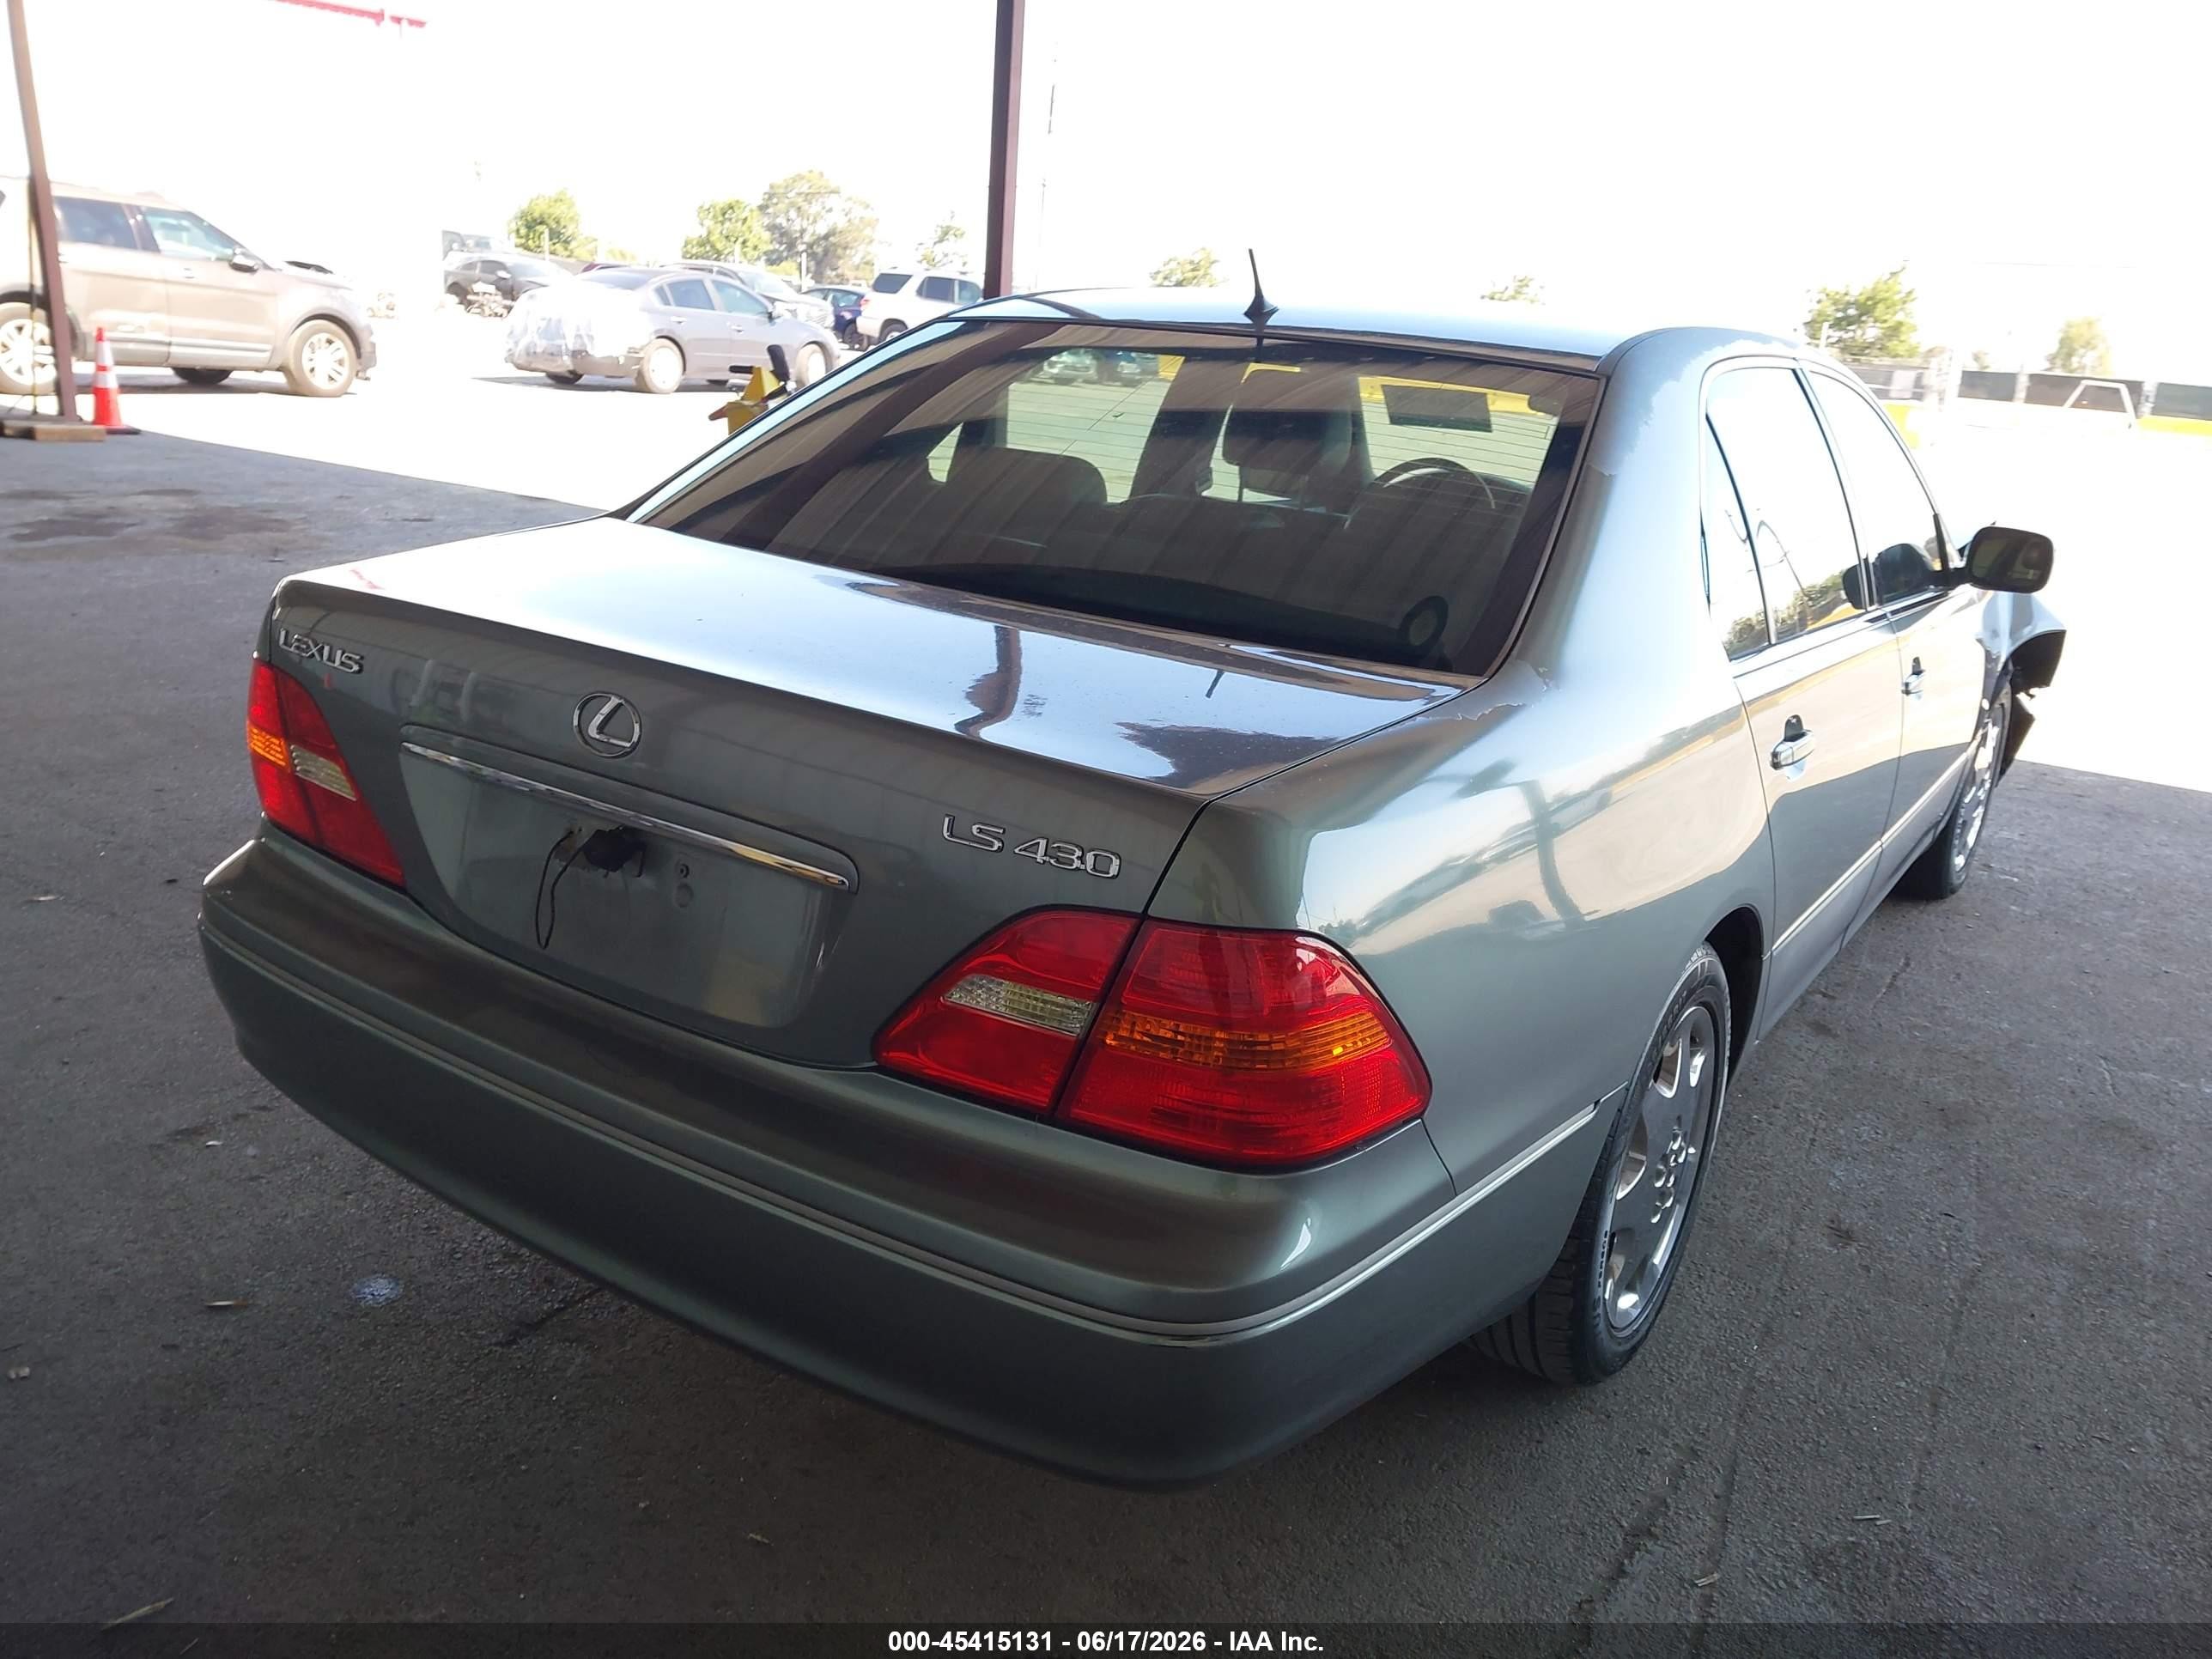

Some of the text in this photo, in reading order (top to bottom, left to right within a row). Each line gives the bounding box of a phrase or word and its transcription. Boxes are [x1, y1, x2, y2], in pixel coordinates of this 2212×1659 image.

[278, 627, 362, 673] LEXUS
[943, 815, 1121, 878] LS 430
